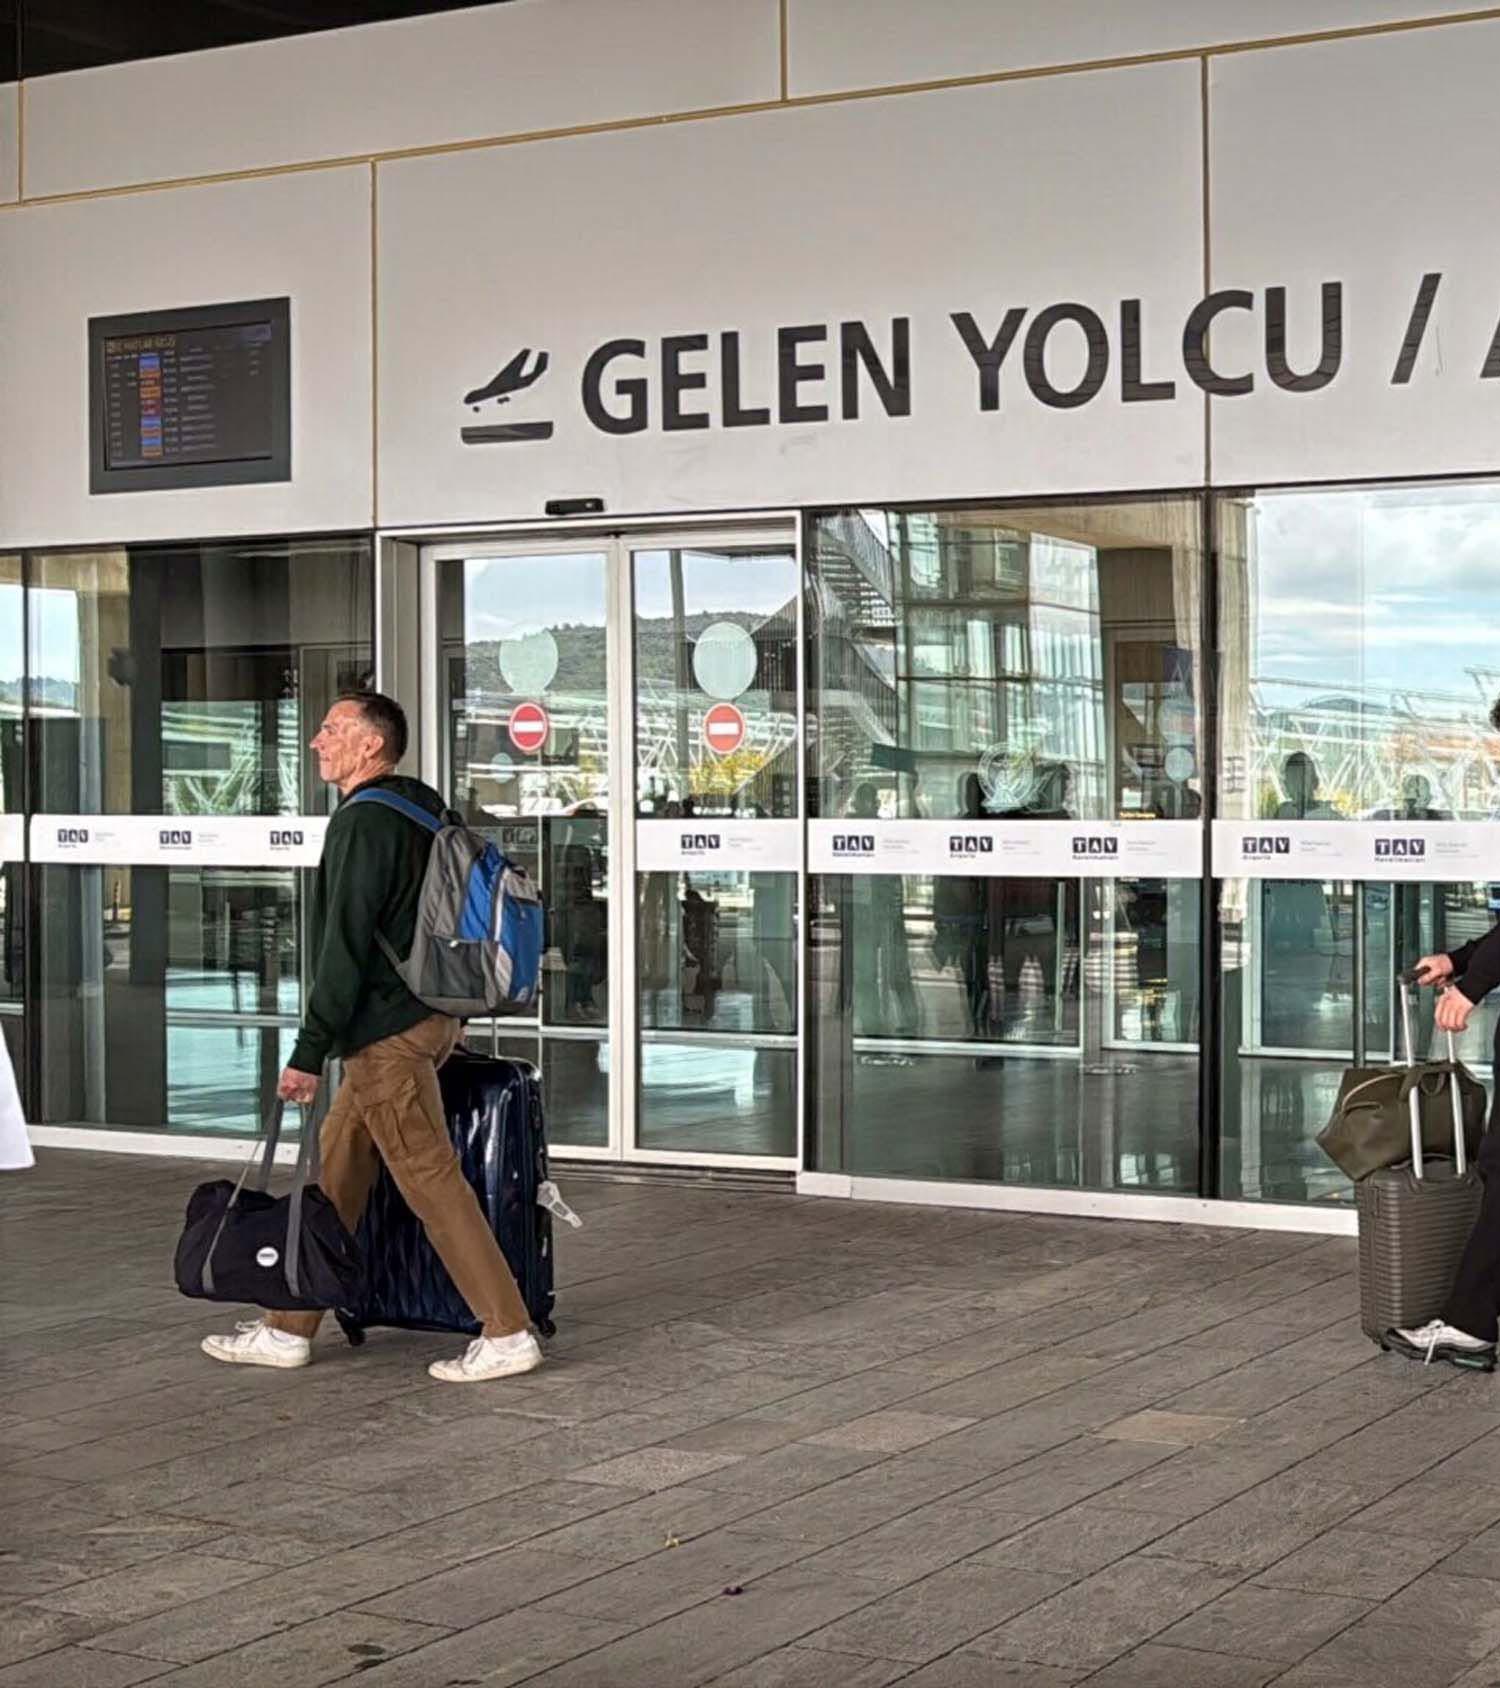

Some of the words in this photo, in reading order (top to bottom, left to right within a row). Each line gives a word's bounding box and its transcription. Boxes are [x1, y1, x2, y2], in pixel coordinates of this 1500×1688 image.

[581, 317, 911, 435] GELEN
[949, 282, 1342, 411] YOLCU
[1390, 273, 1442, 384] /
[681, 834, 720, 849] TAV
[833, 835, 874, 851] TAV
[949, 836, 993, 852] TAV
[1073, 837, 1117, 853] TAV
[1242, 837, 1289, 853] TAV
[1375, 839, 1425, 855] TAV
